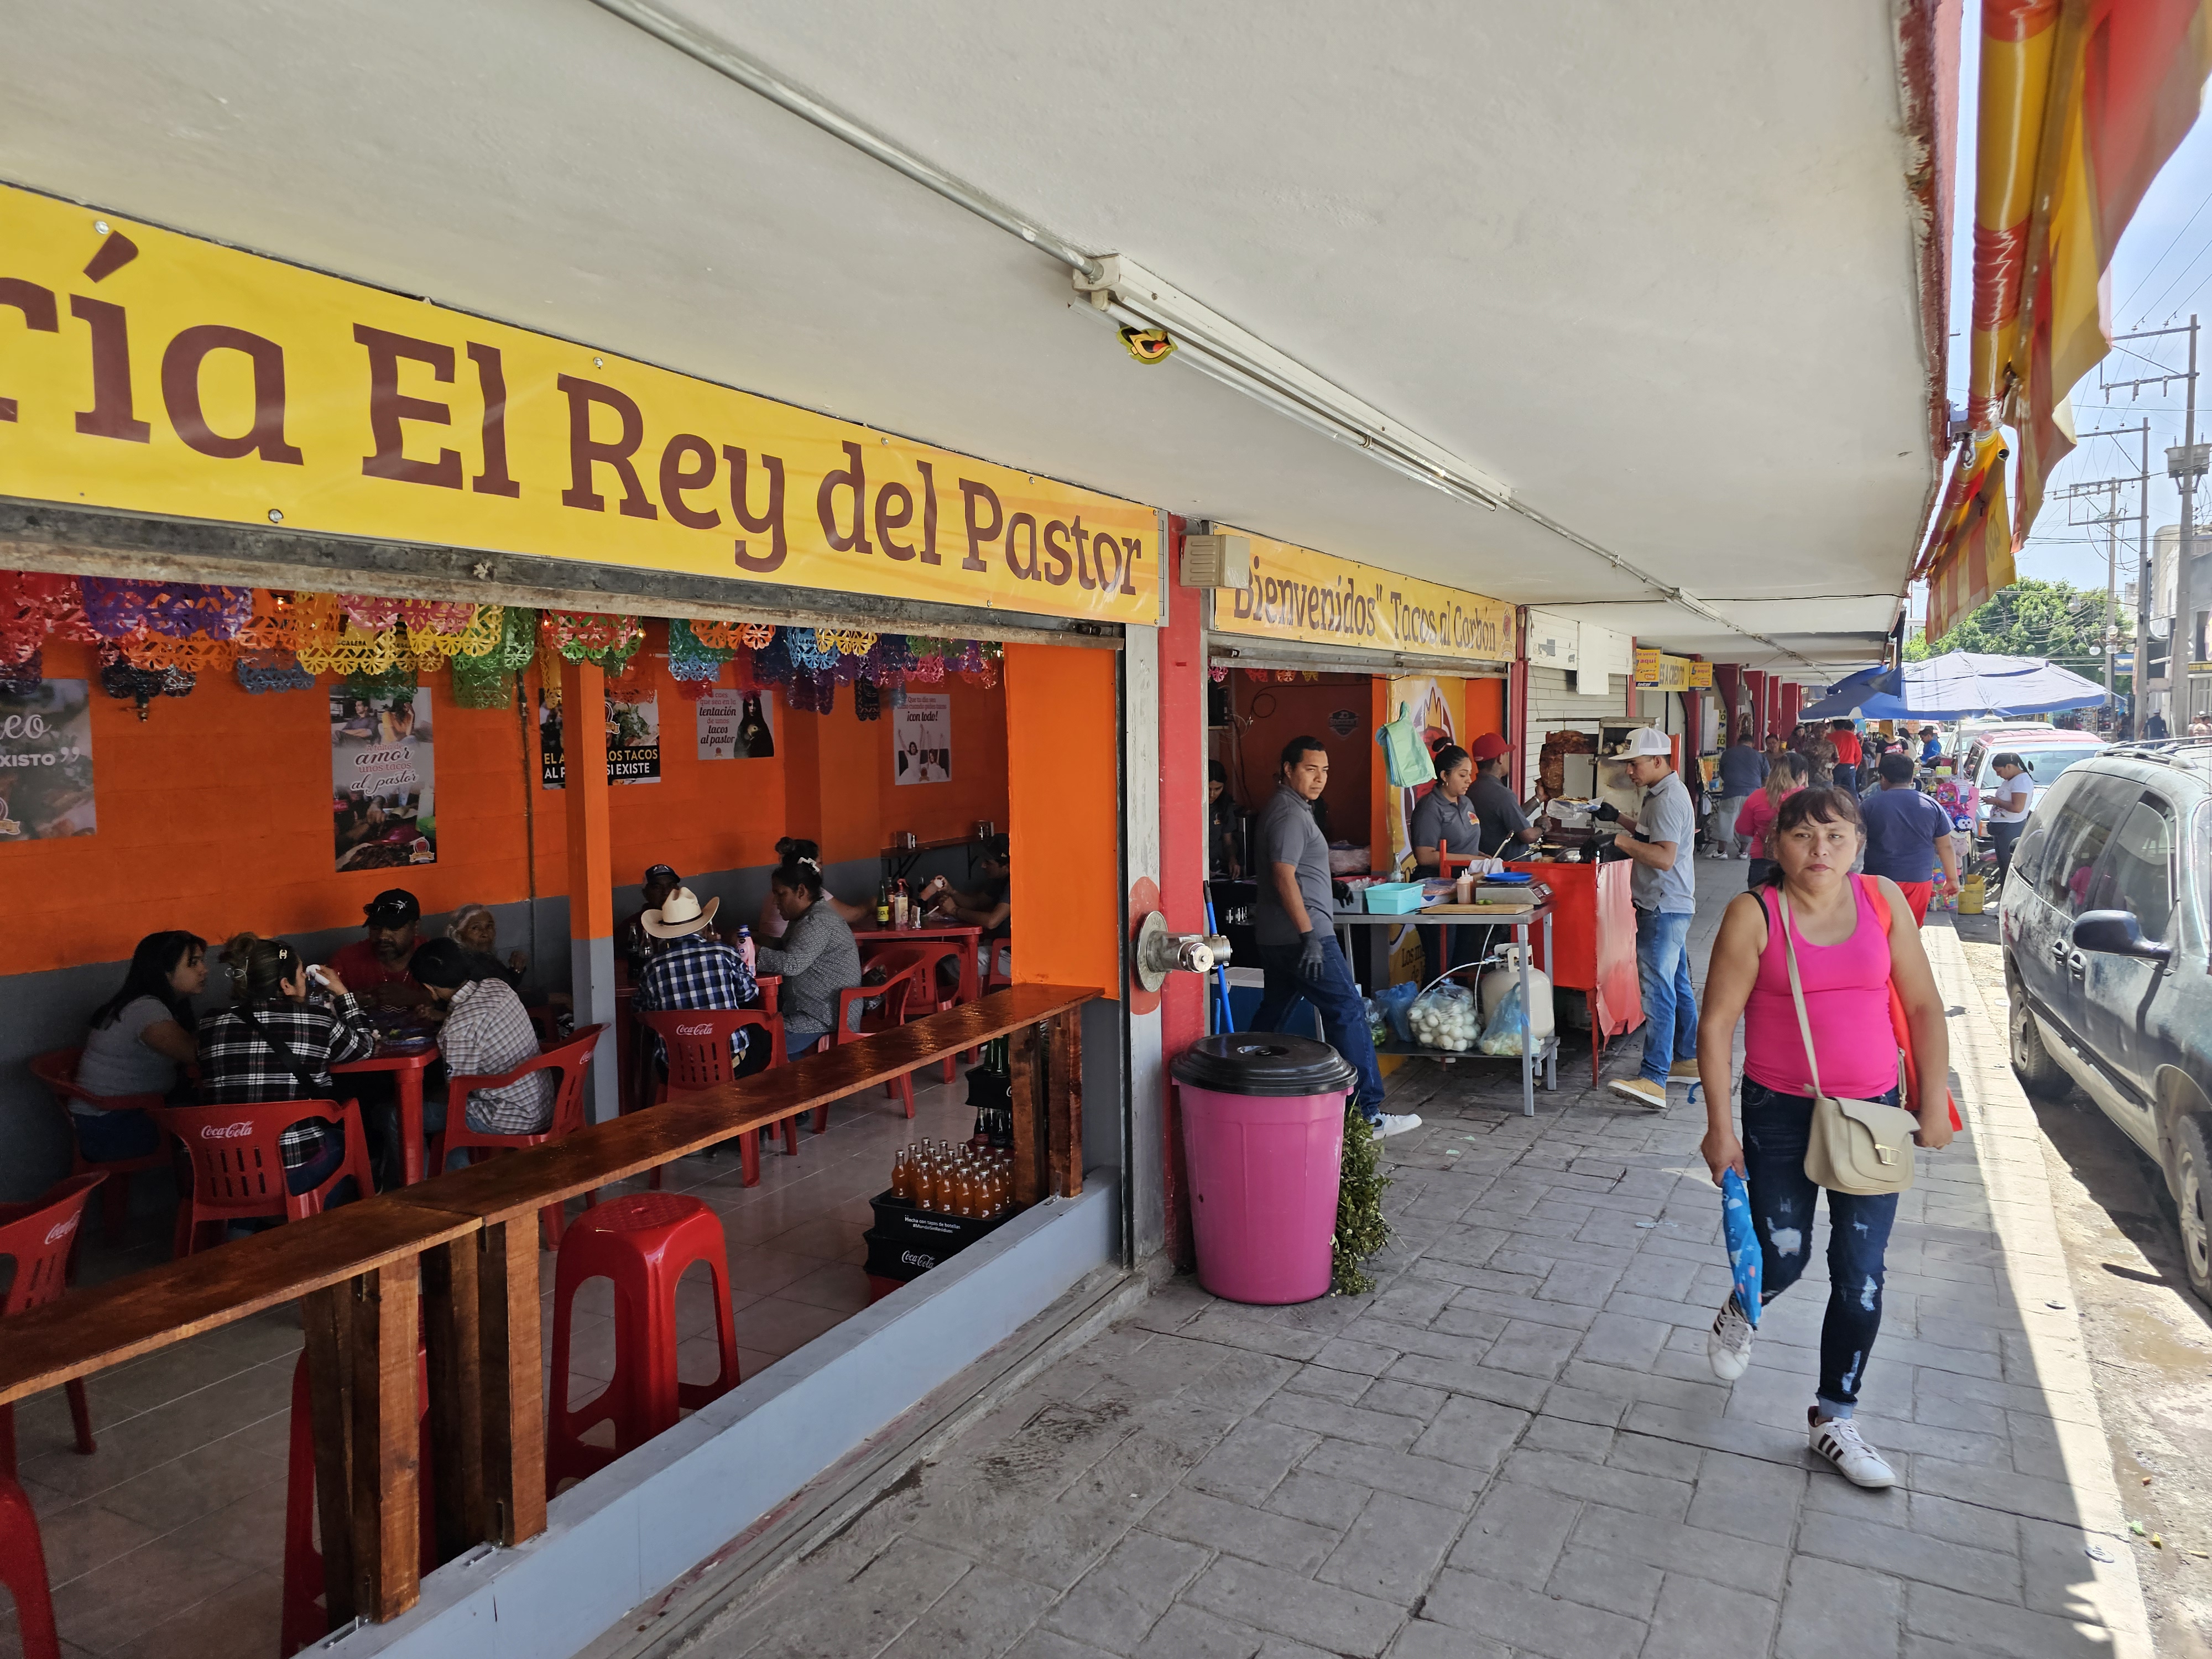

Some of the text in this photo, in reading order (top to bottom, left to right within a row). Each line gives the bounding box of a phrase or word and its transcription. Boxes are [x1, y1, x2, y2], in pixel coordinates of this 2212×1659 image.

[352, 322, 520, 498] El
[557, 373, 787, 573] Rey
[816, 440, 942, 565] del
[959, 477, 1142, 595] Pastor
[1391, 591, 1437, 644] Tacos
[1440, 601, 1451, 646] al
[1454, 606, 1496, 651] Carbón
[700, 706, 736, 716] tentación
[921, 711, 938, 721] todo!
[708, 725, 728, 734] tacos
[701, 735, 735, 747] al pastor
[356, 747, 413, 765] amor
[544, 753, 557, 764] EL
[624, 749, 658, 760] TACOS
[359, 764, 383, 773] unos
[544, 768, 559, 779] AL
[617, 763, 650, 774] EXISTE
[351, 770, 418, 796] al pastor
[1402, 948, 1414, 968] Los
[676, 1023, 714, 1035] Coca-Cola
[201, 1121, 254, 1139] Coca-Cola
[902, 1250, 936, 1269] Coca-Cola
